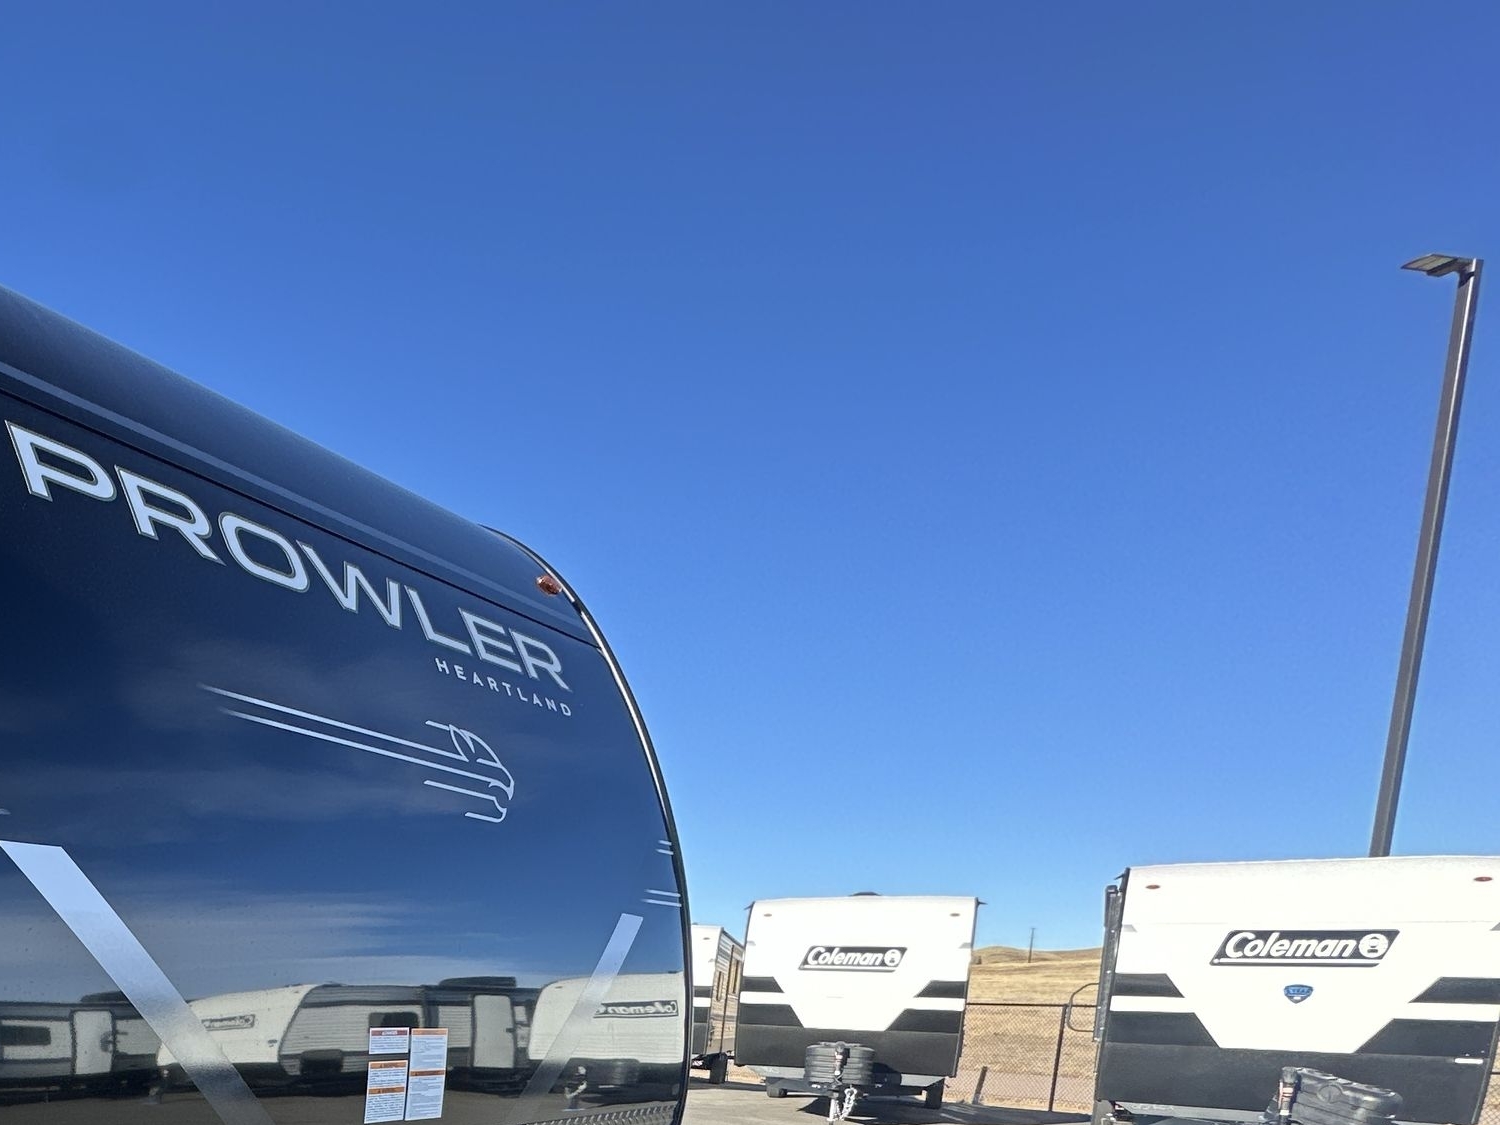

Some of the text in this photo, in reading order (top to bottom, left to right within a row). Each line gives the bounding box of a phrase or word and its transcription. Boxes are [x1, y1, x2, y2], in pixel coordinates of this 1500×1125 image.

[4, 420, 572, 692] PROWLER
[435, 657, 572, 717] HEARTLAND
[807, 946, 884, 966] Coleman
[1225, 931, 1357, 958] Coleman
